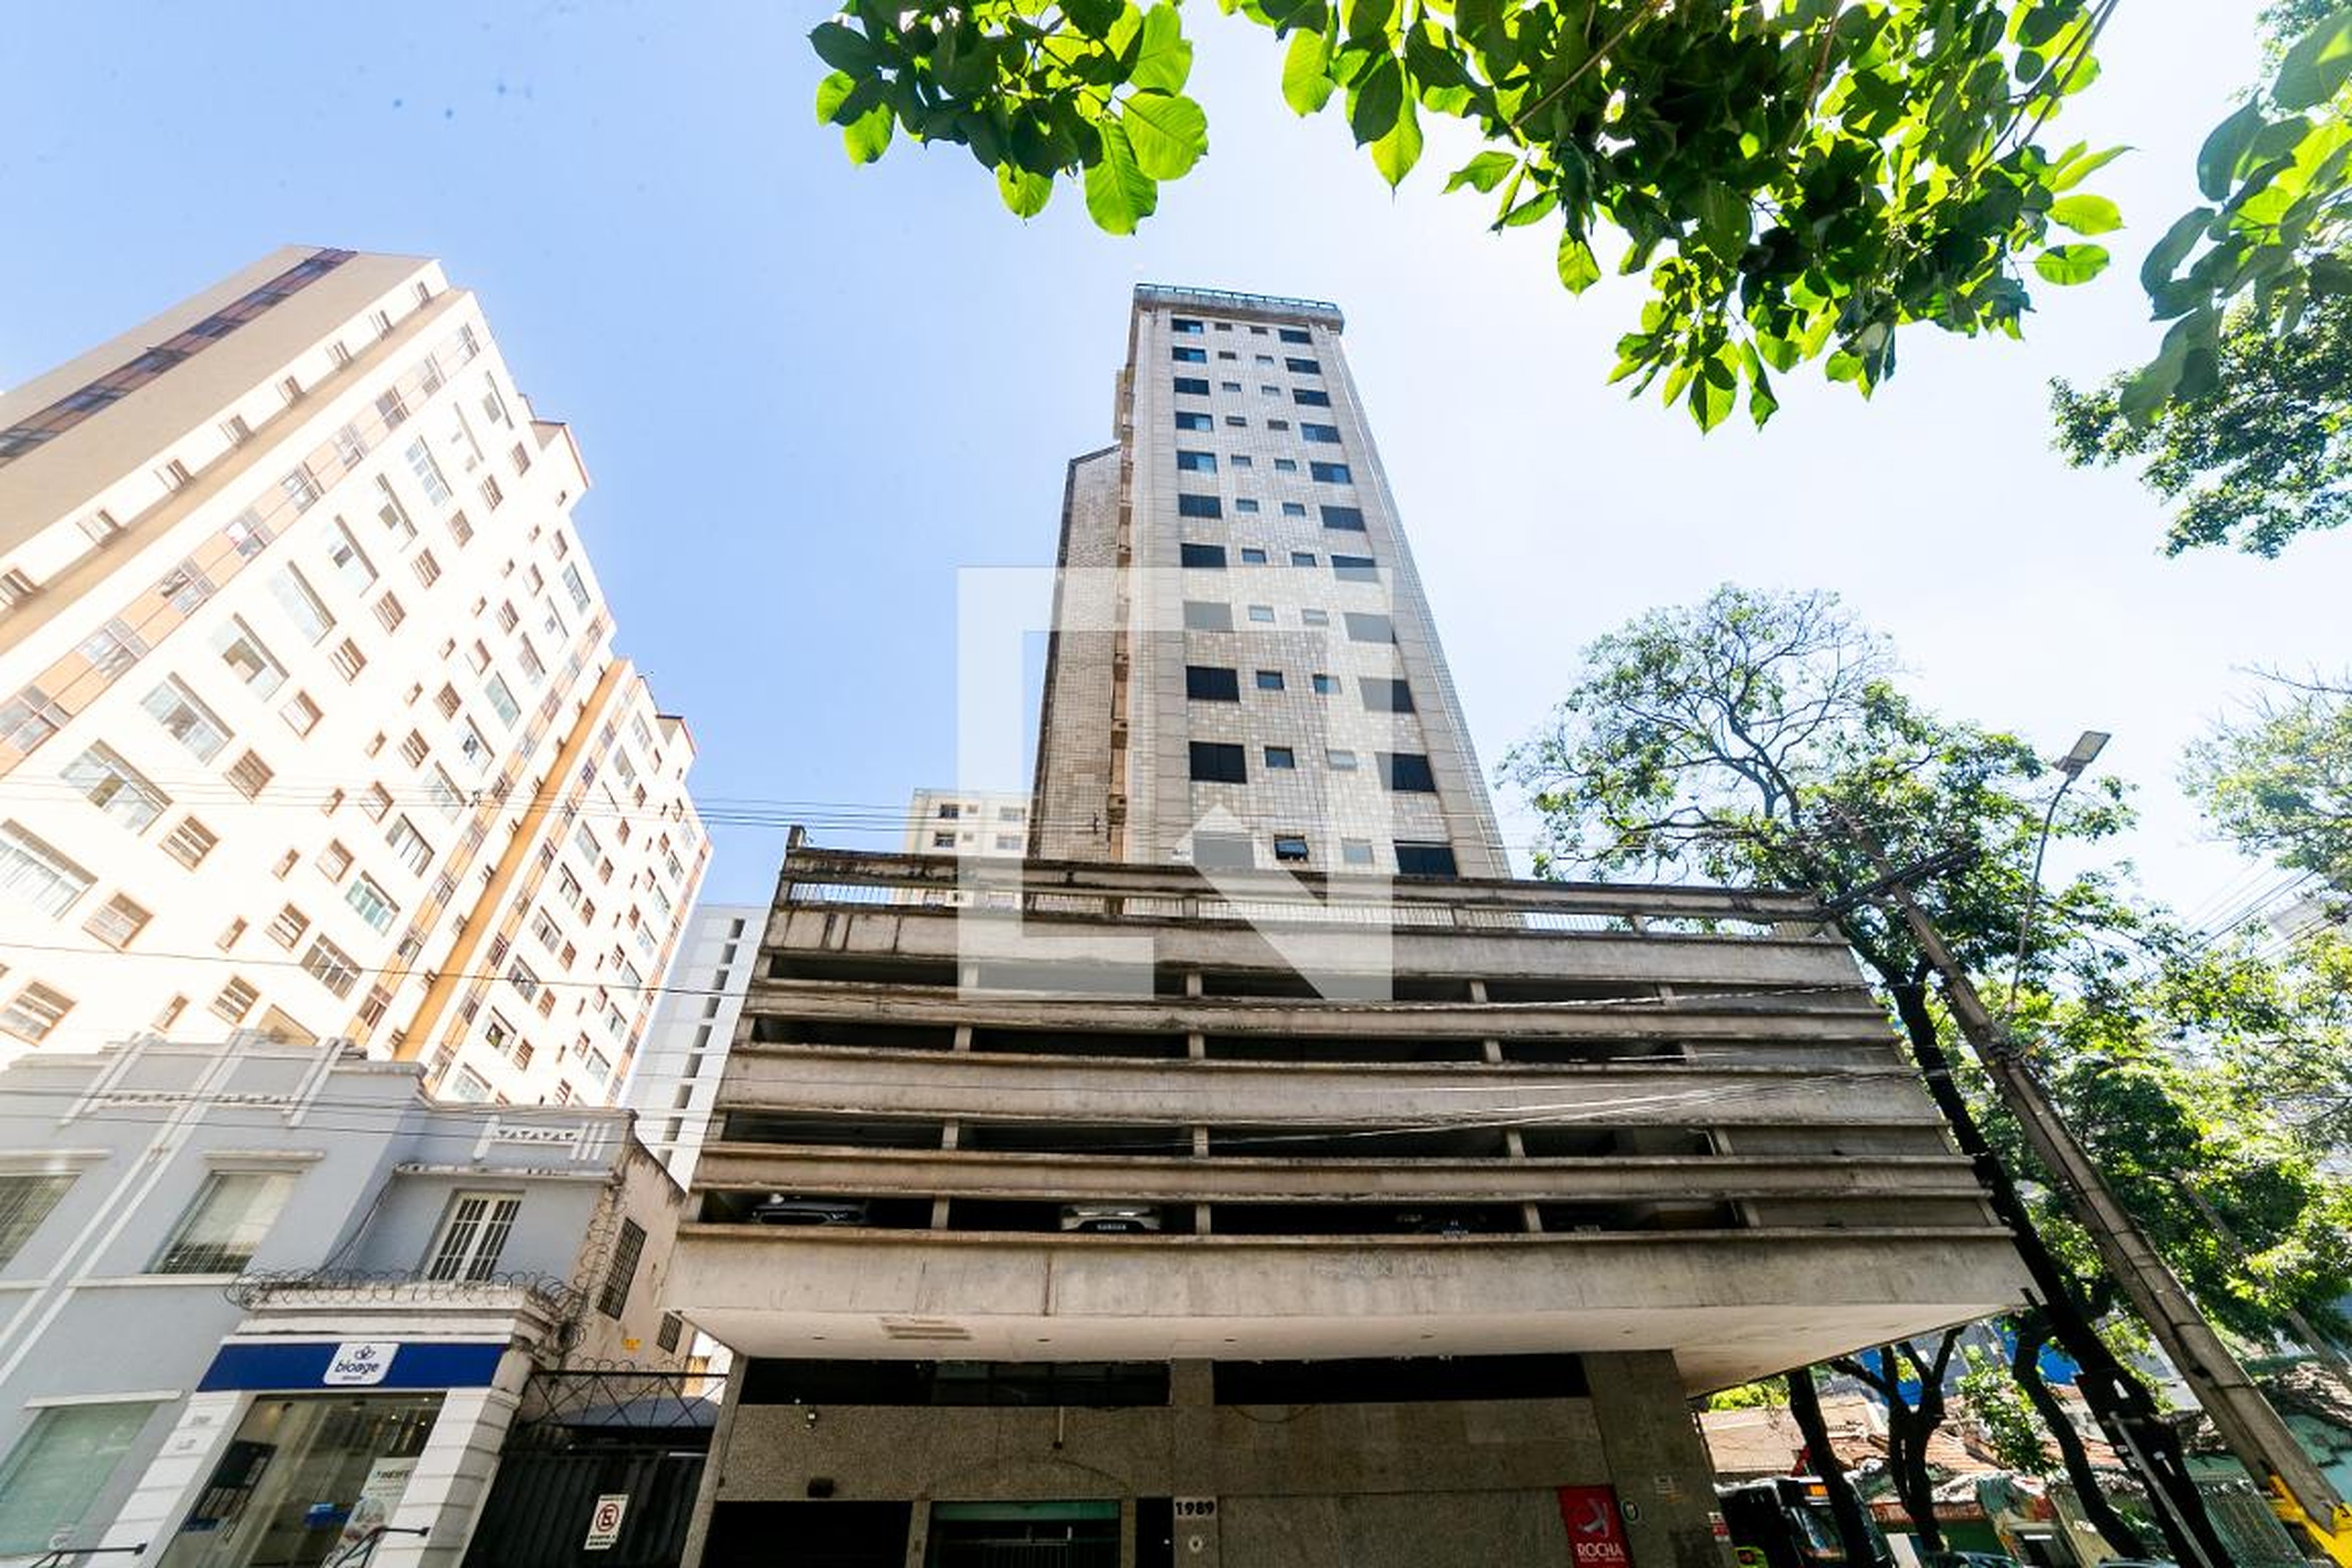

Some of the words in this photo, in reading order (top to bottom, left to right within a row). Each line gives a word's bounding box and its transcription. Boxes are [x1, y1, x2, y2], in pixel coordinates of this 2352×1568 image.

[334, 1359, 380, 1374] bioage
[1175, 1500, 1215, 1515] 1989
[1577, 1542, 1624, 1557] ROCHA
